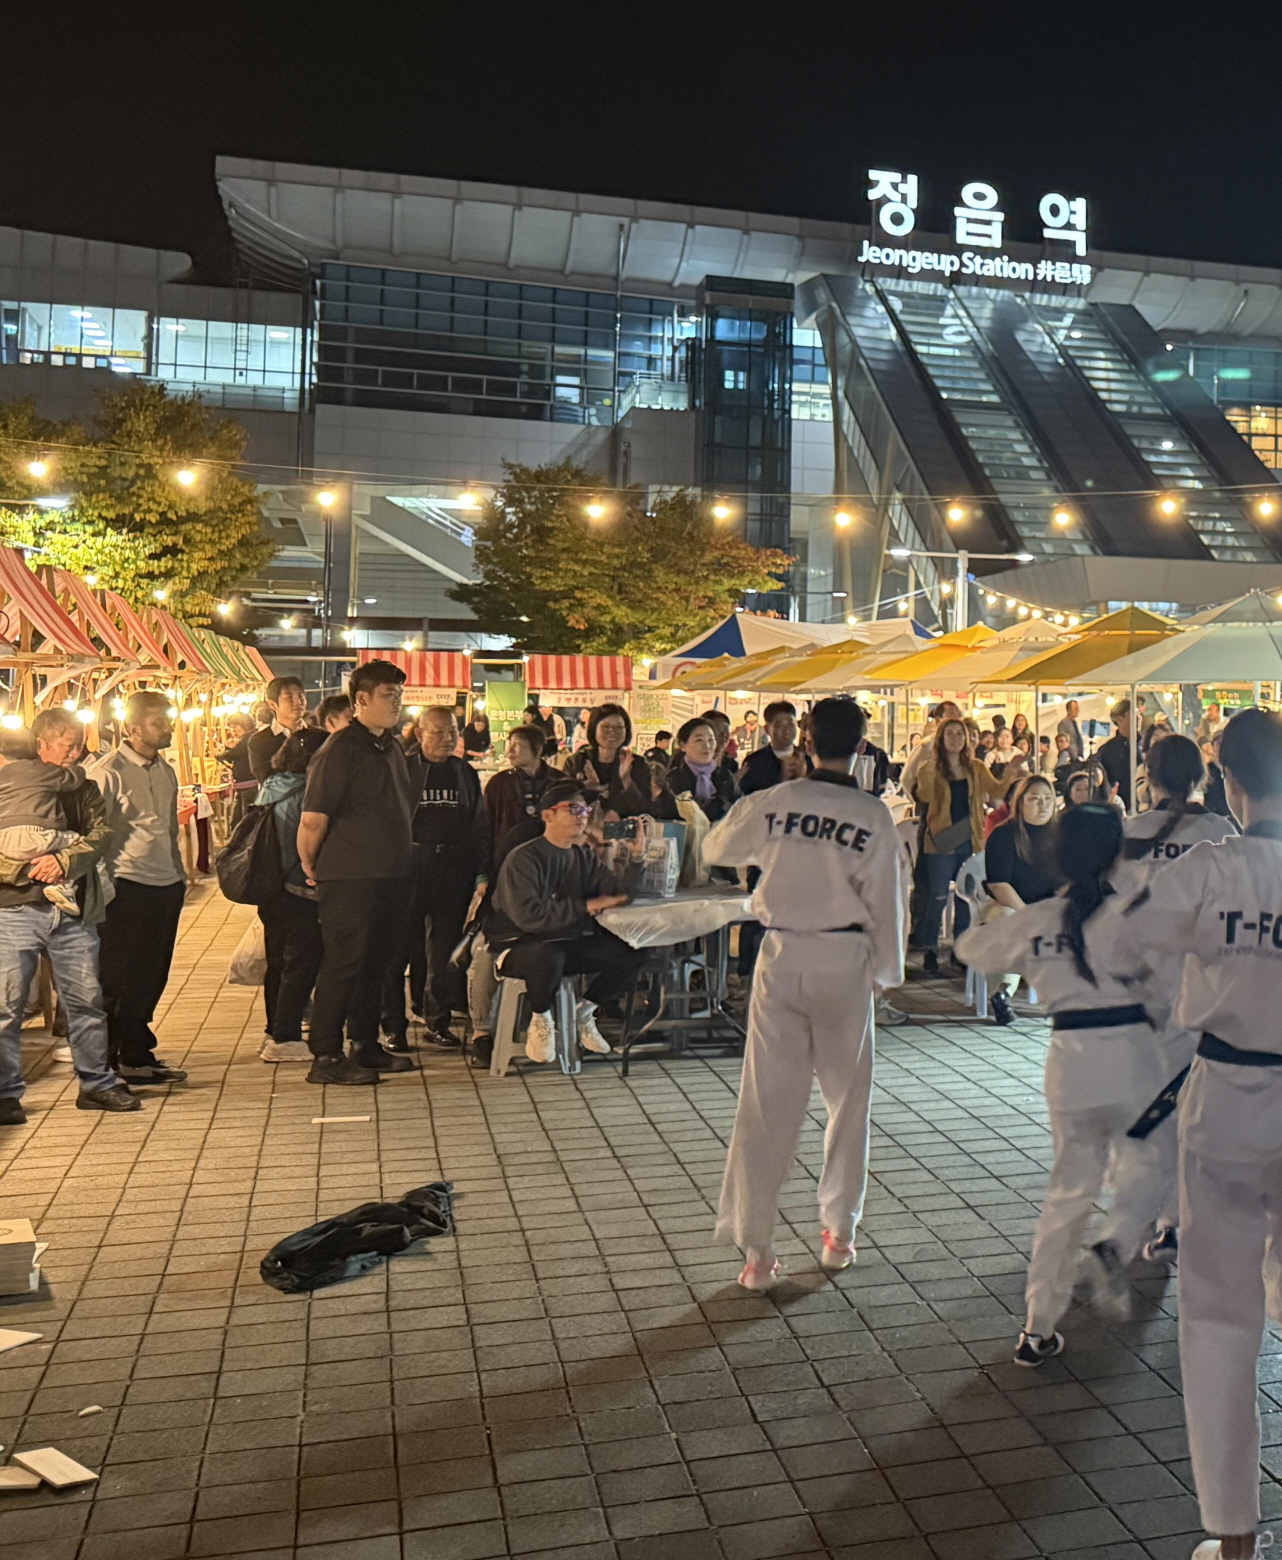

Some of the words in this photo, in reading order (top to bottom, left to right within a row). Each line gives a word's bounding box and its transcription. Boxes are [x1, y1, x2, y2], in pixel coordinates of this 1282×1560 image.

[867, 169, 1088, 257] 정읍역
[857, 240, 960, 277] Jeongeup
[961, 251, 1034, 280] Station
[1036, 260, 1092, 285] 井邑驛
[765, 812, 873, 852] T-FORCE
